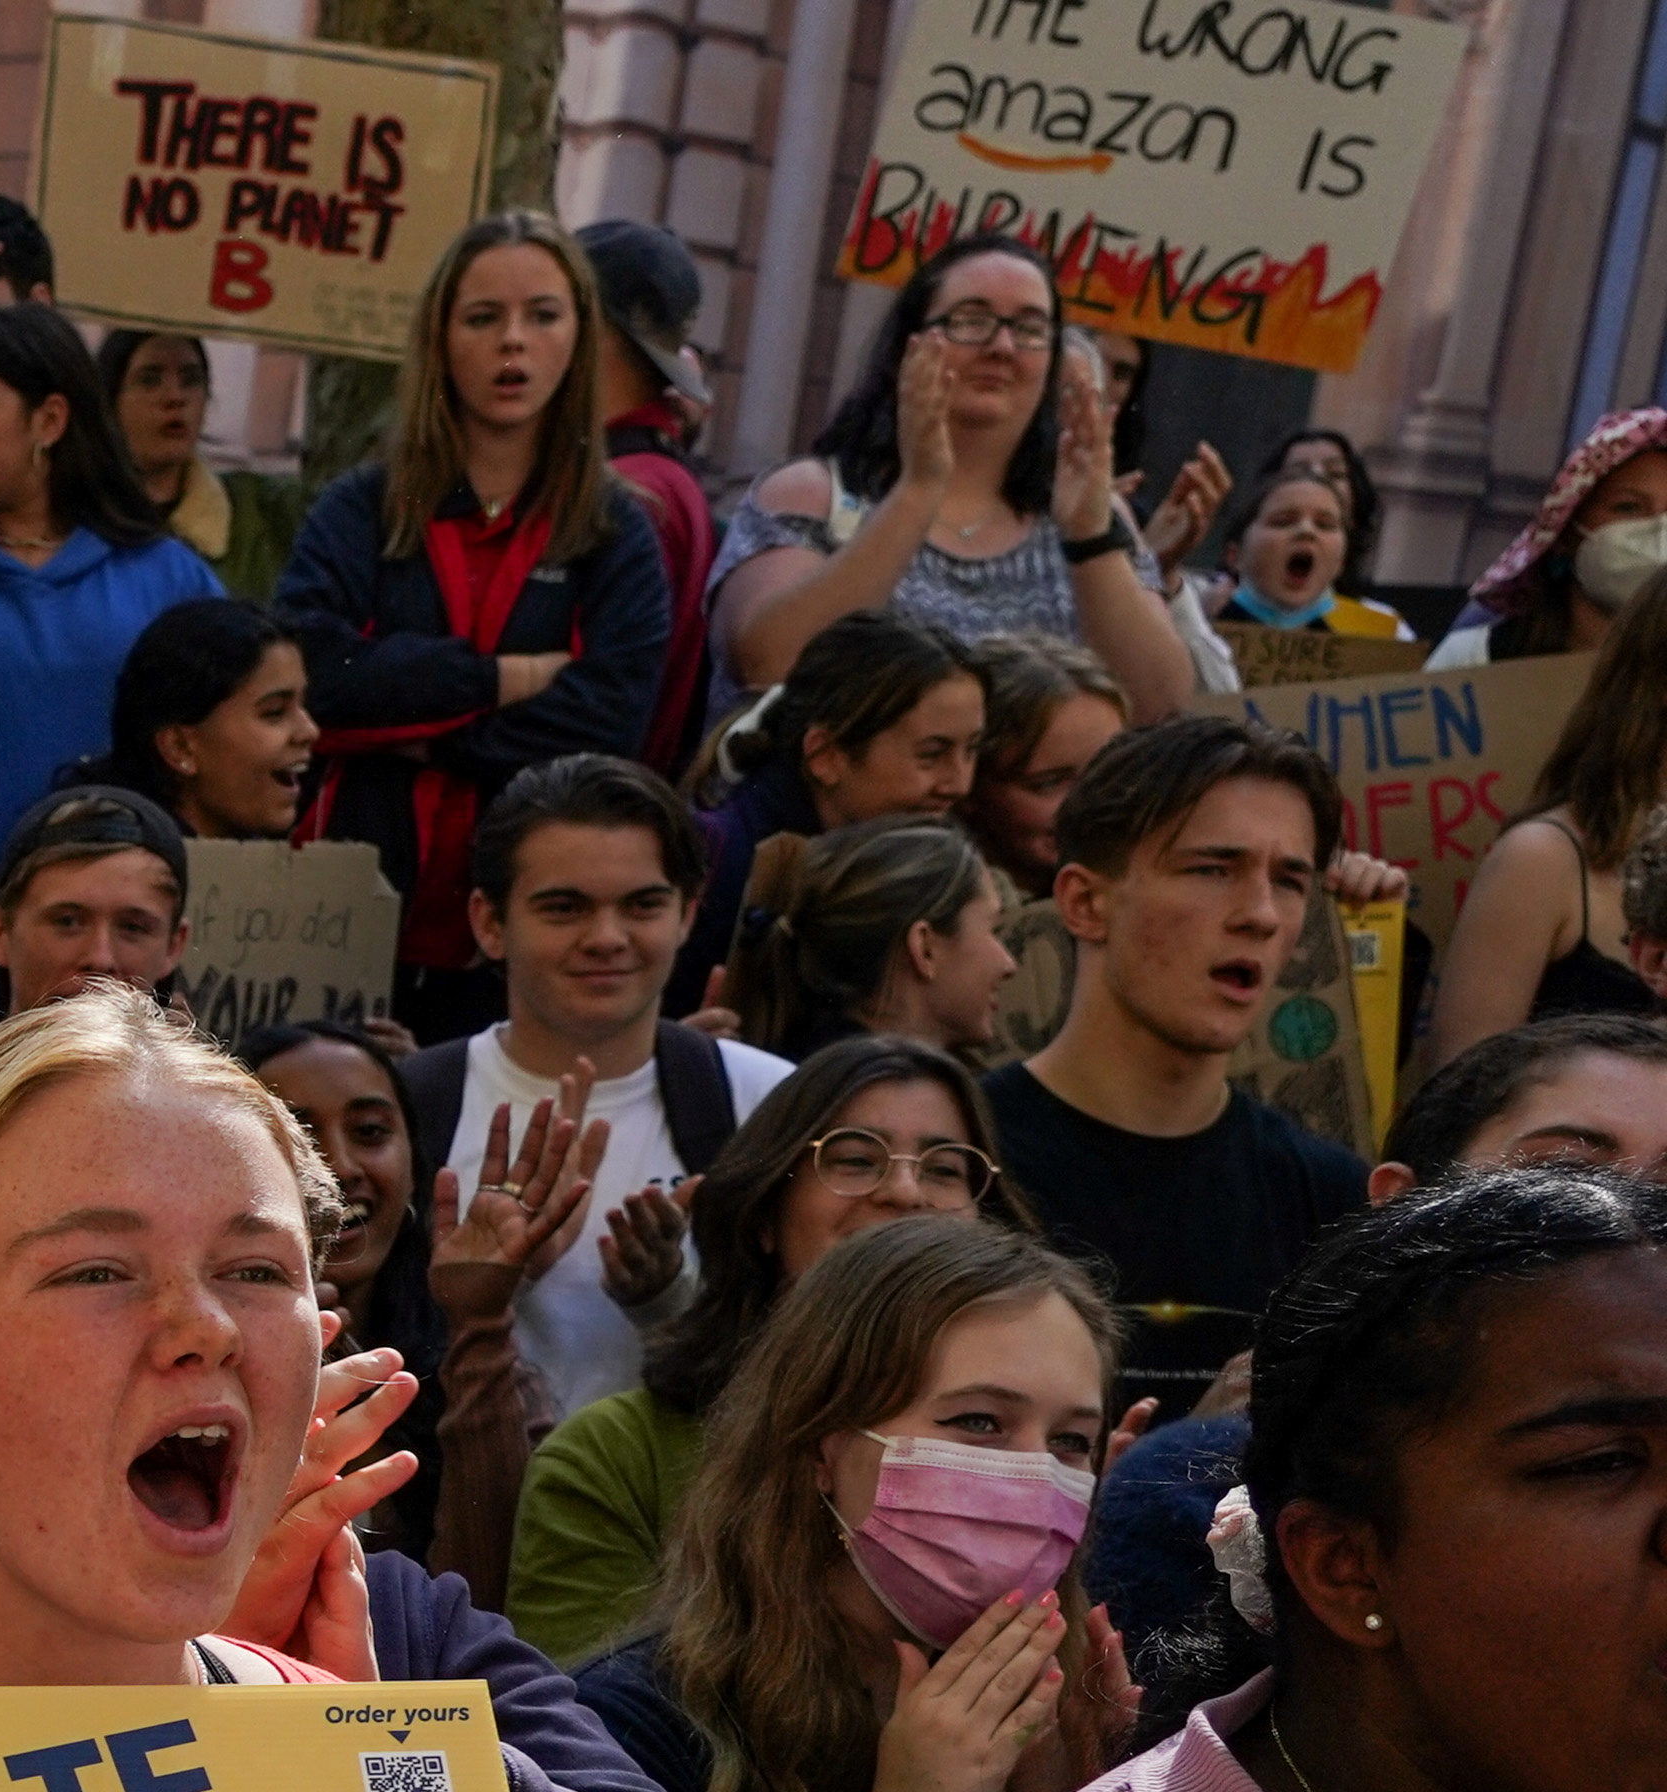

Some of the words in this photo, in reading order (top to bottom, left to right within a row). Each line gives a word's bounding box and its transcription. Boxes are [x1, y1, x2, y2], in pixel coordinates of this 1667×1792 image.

[1138, 0, 1400, 95] WRONG
[116, 80, 319, 175] THERE
[345, 113, 405, 194] IS
[913, 62, 1239, 173] amazon
[1297, 128, 1376, 198] IS
[123, 176, 202, 234] NO
[223, 178, 405, 263] PLANET
[210, 239, 274, 314] B
[325, 1705, 396, 1724] Order
[404, 1706, 470, 1726] yours
